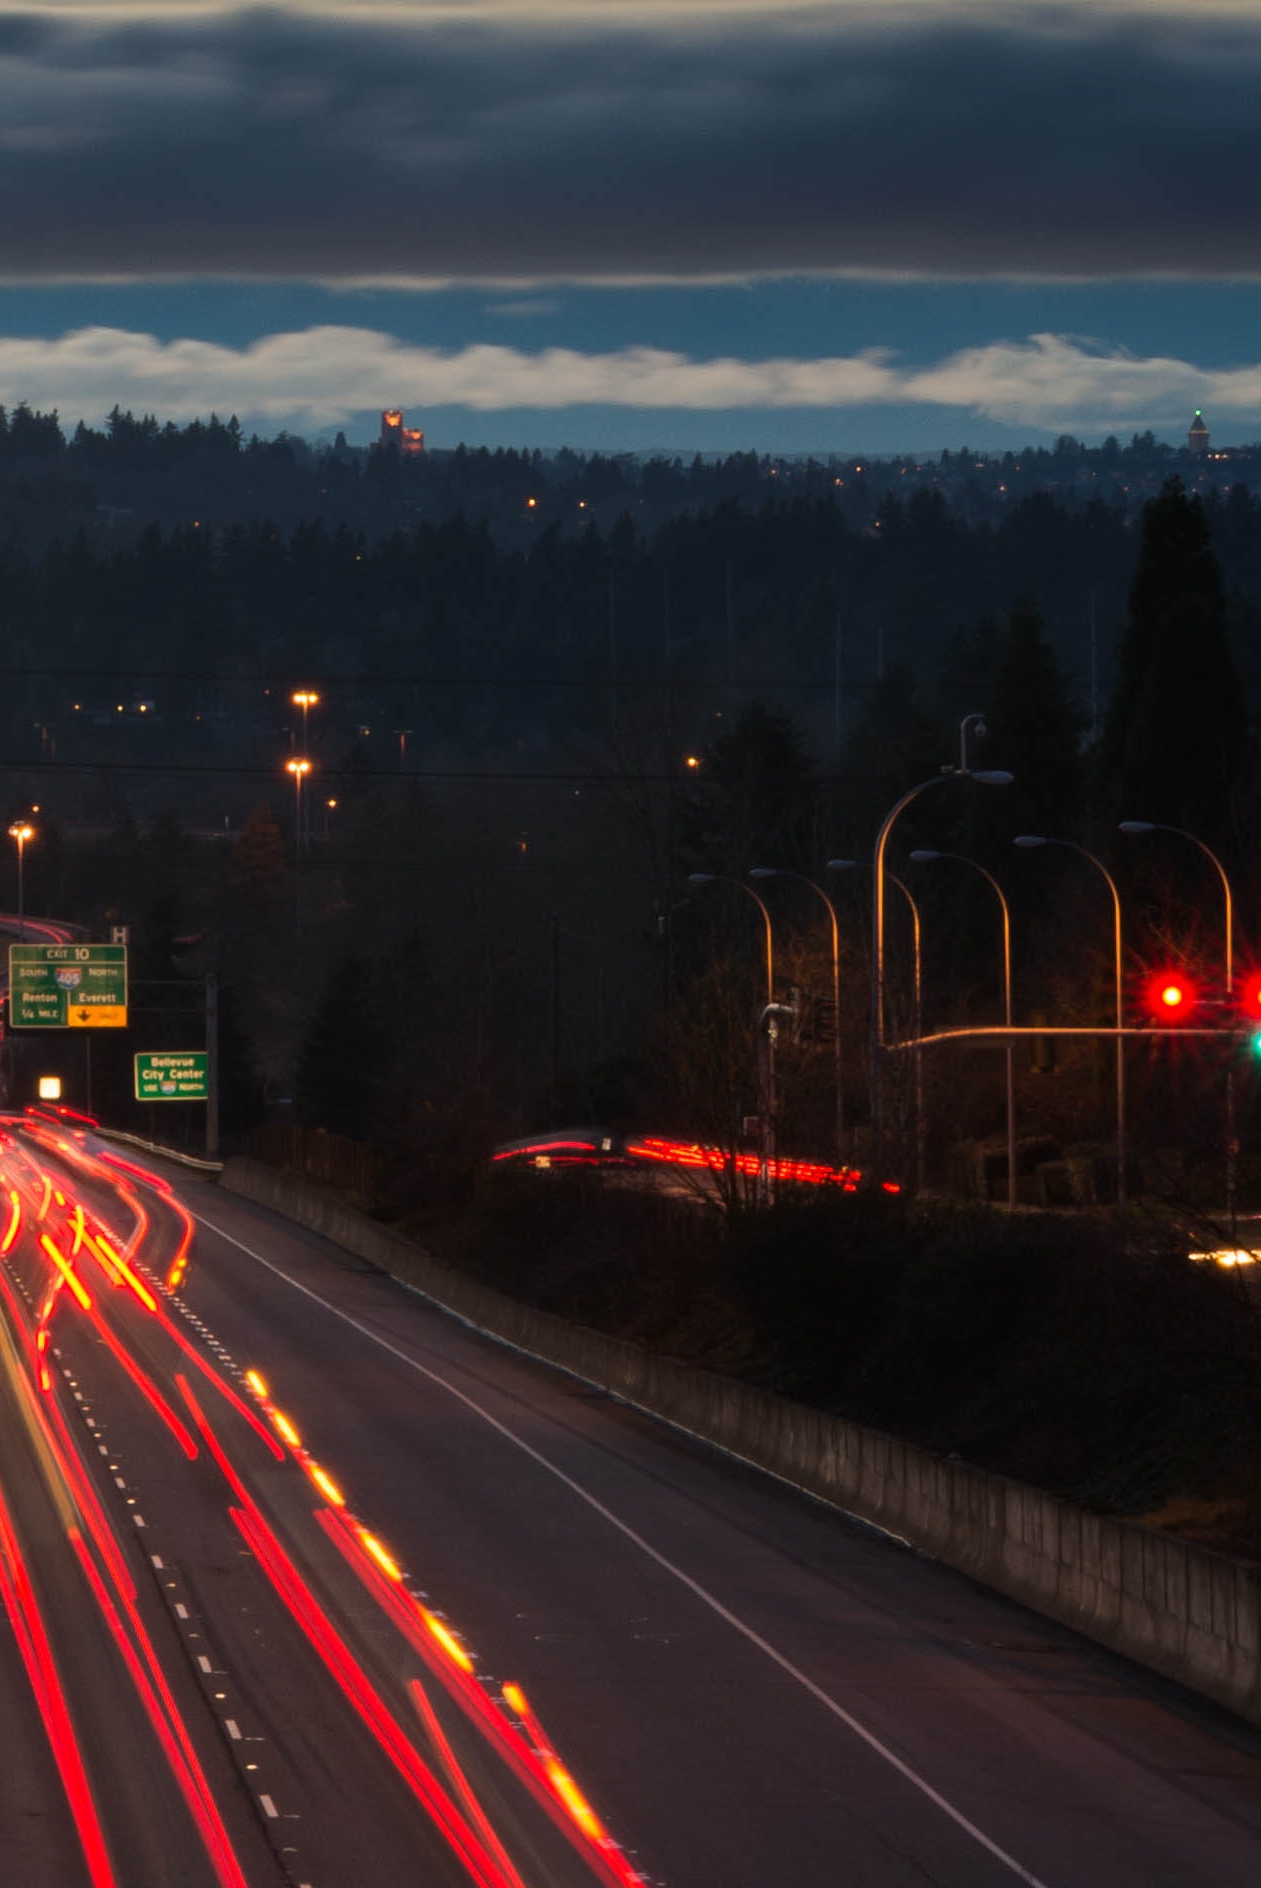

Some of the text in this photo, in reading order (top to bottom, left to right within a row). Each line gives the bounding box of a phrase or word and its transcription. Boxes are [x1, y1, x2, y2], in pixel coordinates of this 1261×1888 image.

[47, 948, 90, 961] EXIT 10
[19, 968, 48, 977] SOUTH
[57, 972, 80, 983] 405
[89, 968, 118, 977] NORTH
[22, 992, 57, 1003] Renton
[79, 993, 116, 1003] Everett
[38, 1009, 58, 1018] MILE
[151, 1057, 195, 1067] Bellevue
[142, 1069, 204, 1081] City Center
